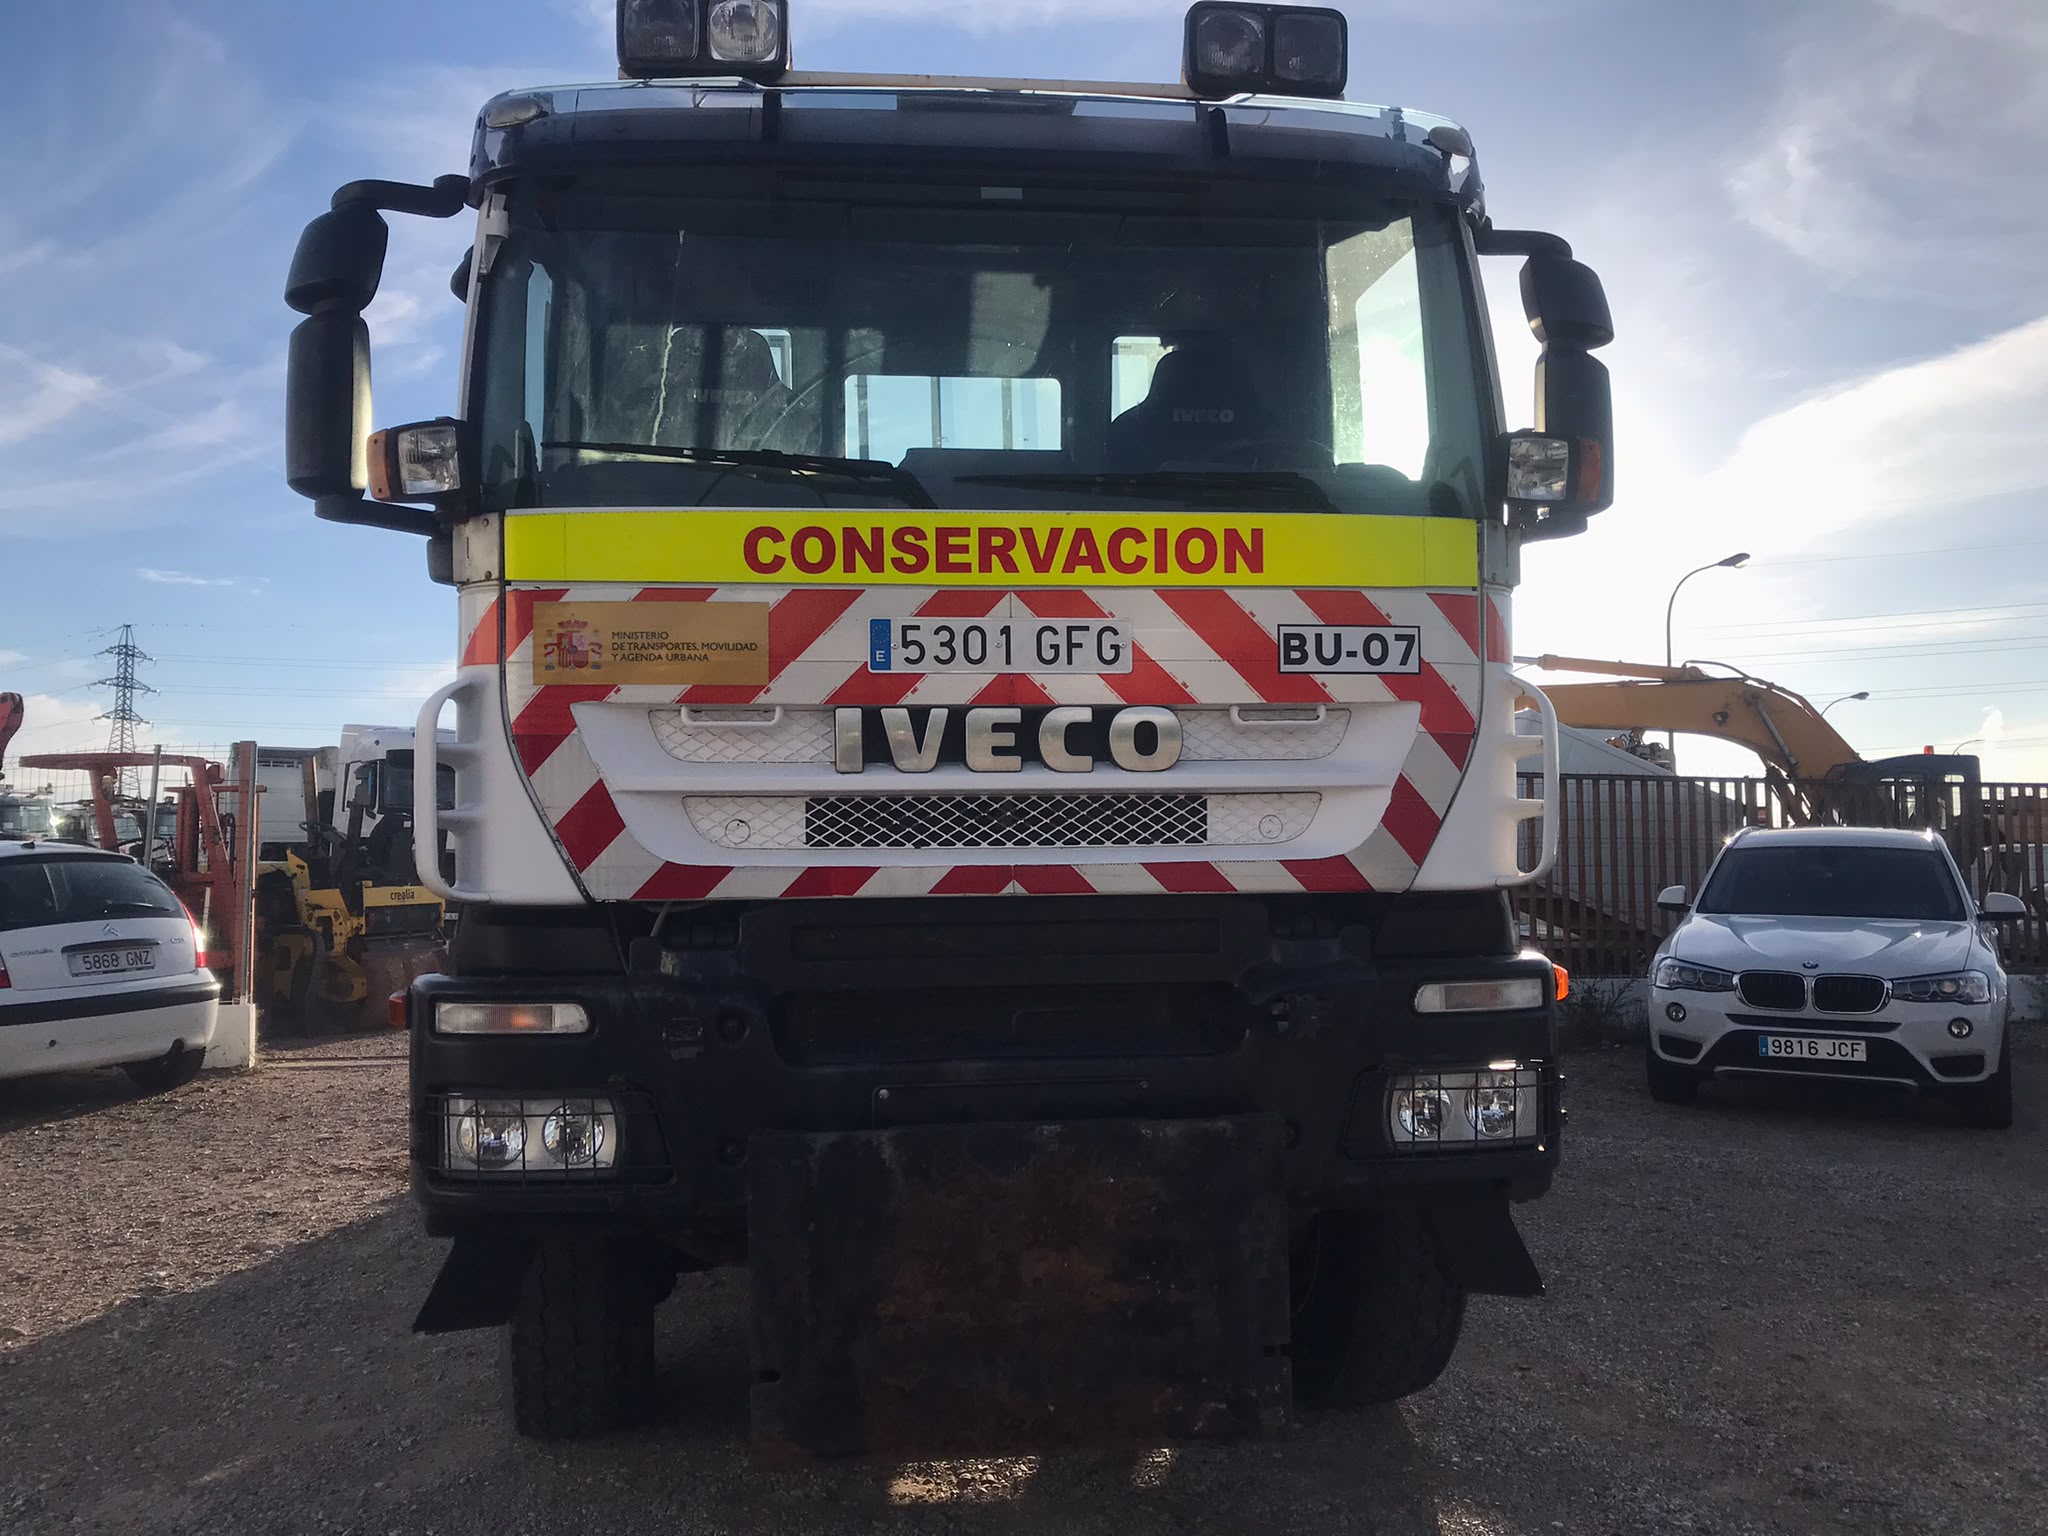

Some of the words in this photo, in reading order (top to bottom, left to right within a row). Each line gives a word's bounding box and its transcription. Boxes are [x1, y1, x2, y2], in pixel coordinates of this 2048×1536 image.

[743, 526, 1265, 575] CONSERVACION
[611, 631, 670, 641] MINISTERIO
[901, 625, 1012, 666] 5301
[1035, 625, 1121, 666] GFG
[611, 641, 626, 651] DE
[626, 641, 700, 652] TRANSPORTES,
[701, 642, 758, 652] MOVILIDAD
[1283, 632, 1416, 667] BU-07
[611, 653, 619, 662] Y
[619, 652, 664, 662] AGENDA
[665, 652, 710, 662] URBANA
[875, 650, 886, 663] E
[834, 706, 1183, 773] IVECO
[390, 888, 415, 901] crealia
[82, 953, 120, 971] 5868
[126, 950, 152, 966] GNZ
[1771, 1039, 1819, 1056] 9816
[1826, 1041, 1862, 1058] JCF
